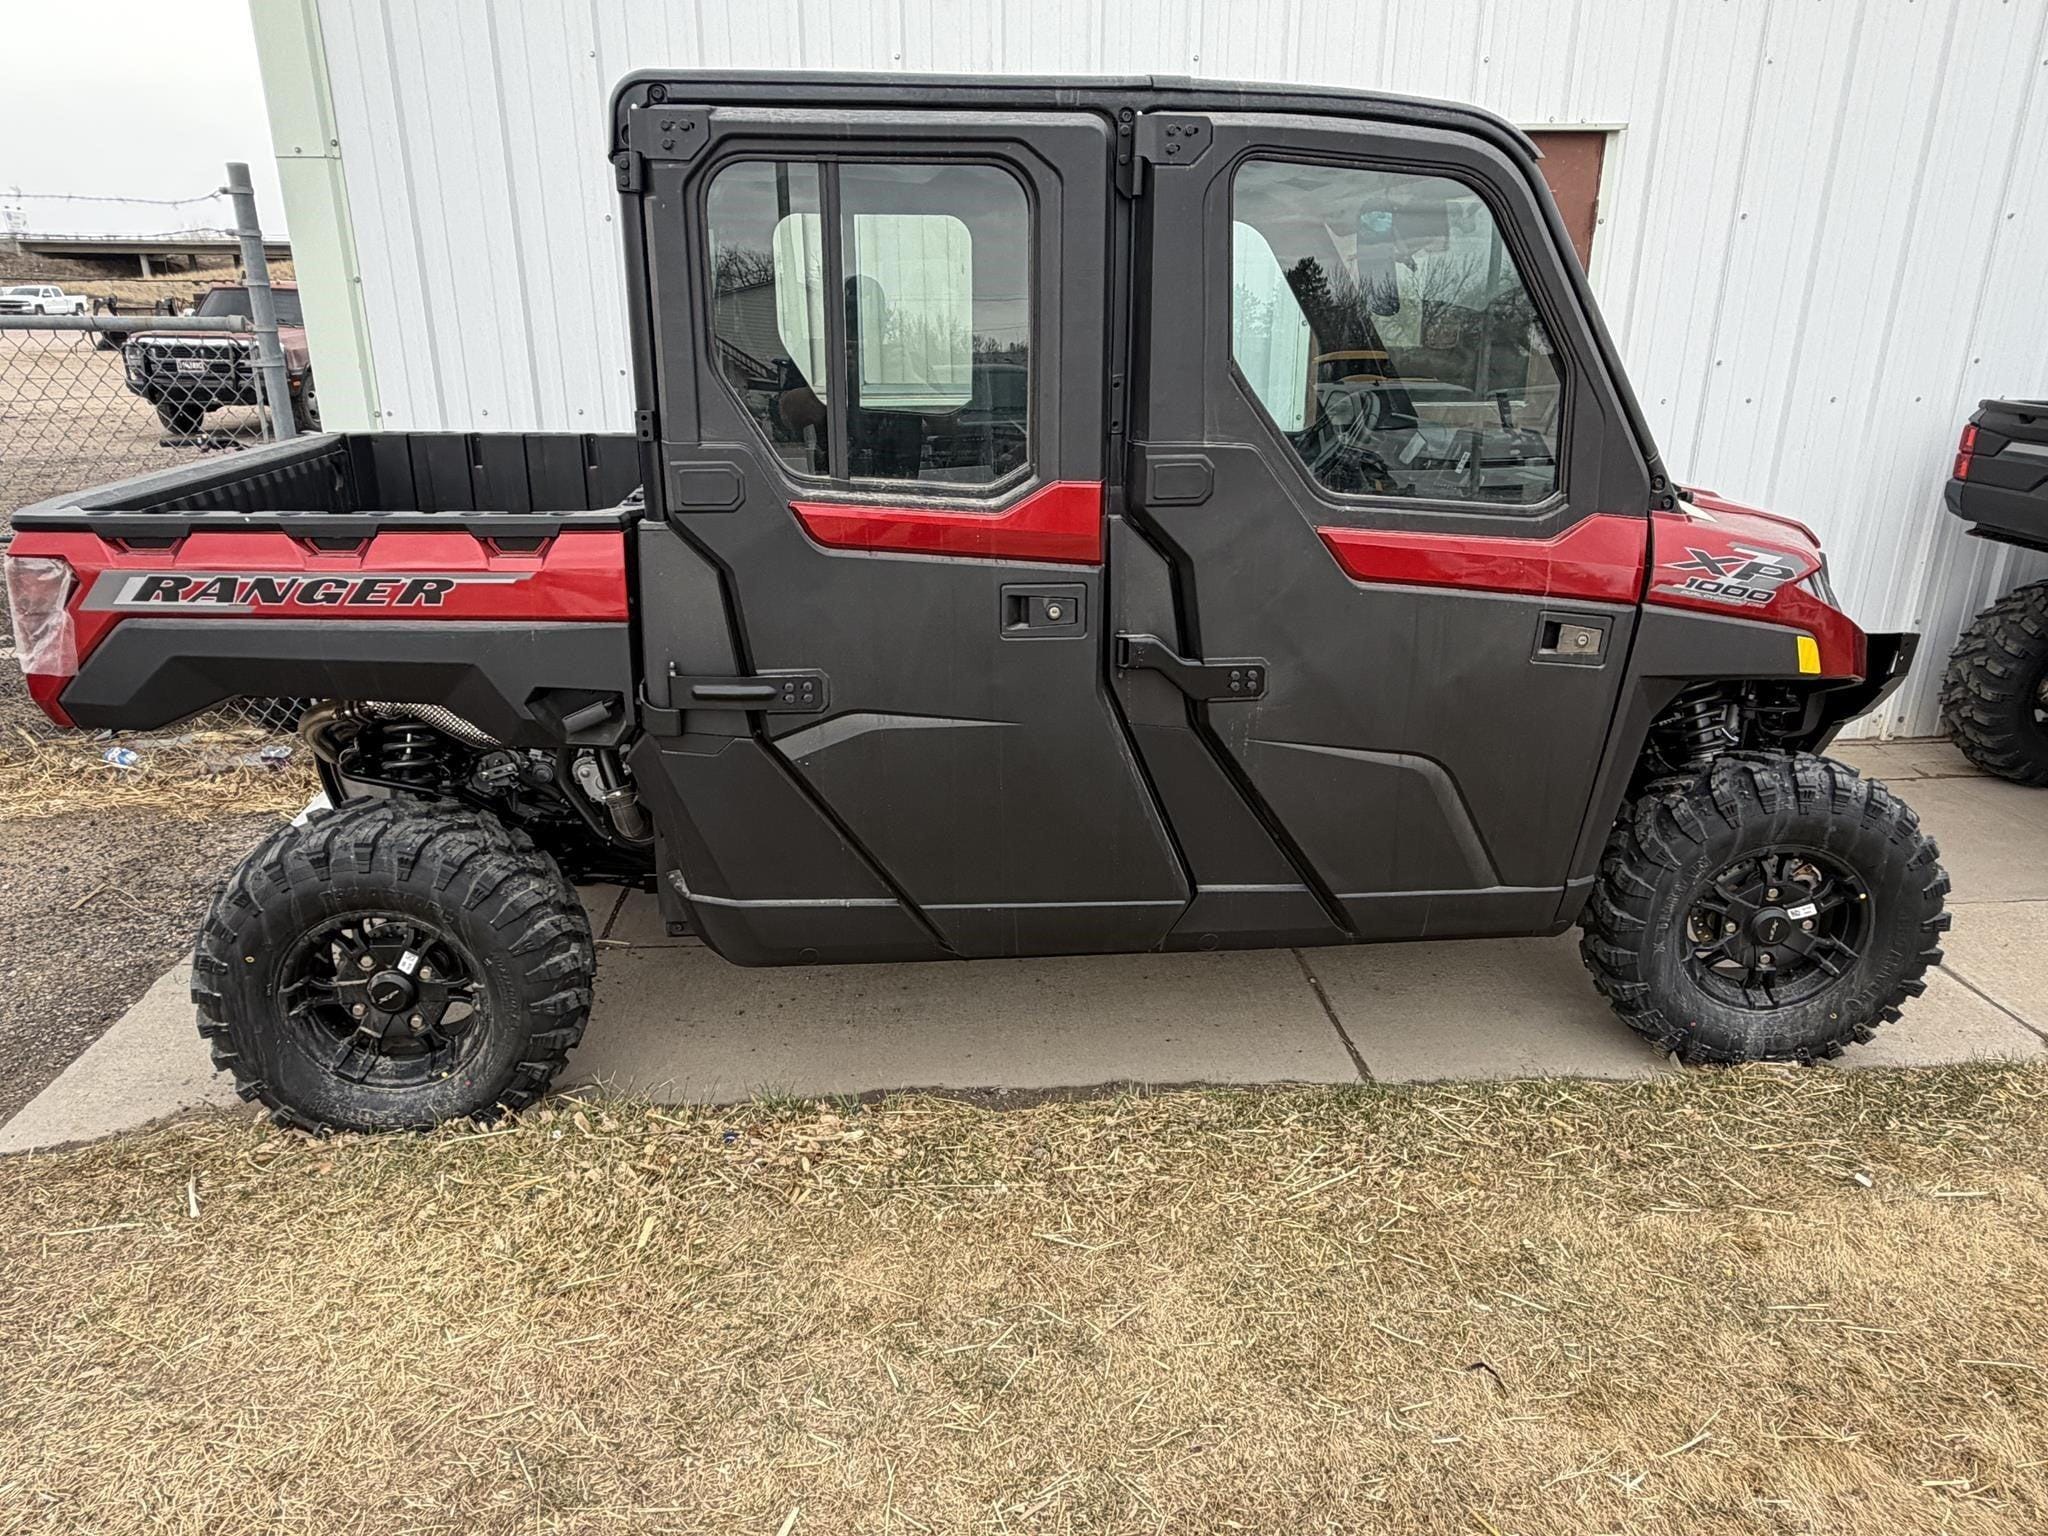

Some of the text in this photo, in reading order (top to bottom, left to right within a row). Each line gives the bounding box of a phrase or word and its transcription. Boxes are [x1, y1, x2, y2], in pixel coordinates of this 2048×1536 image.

[1663, 546, 1797, 582] XP
[130, 574, 456, 607] RANGER
[1685, 576, 1777, 603] 1000
